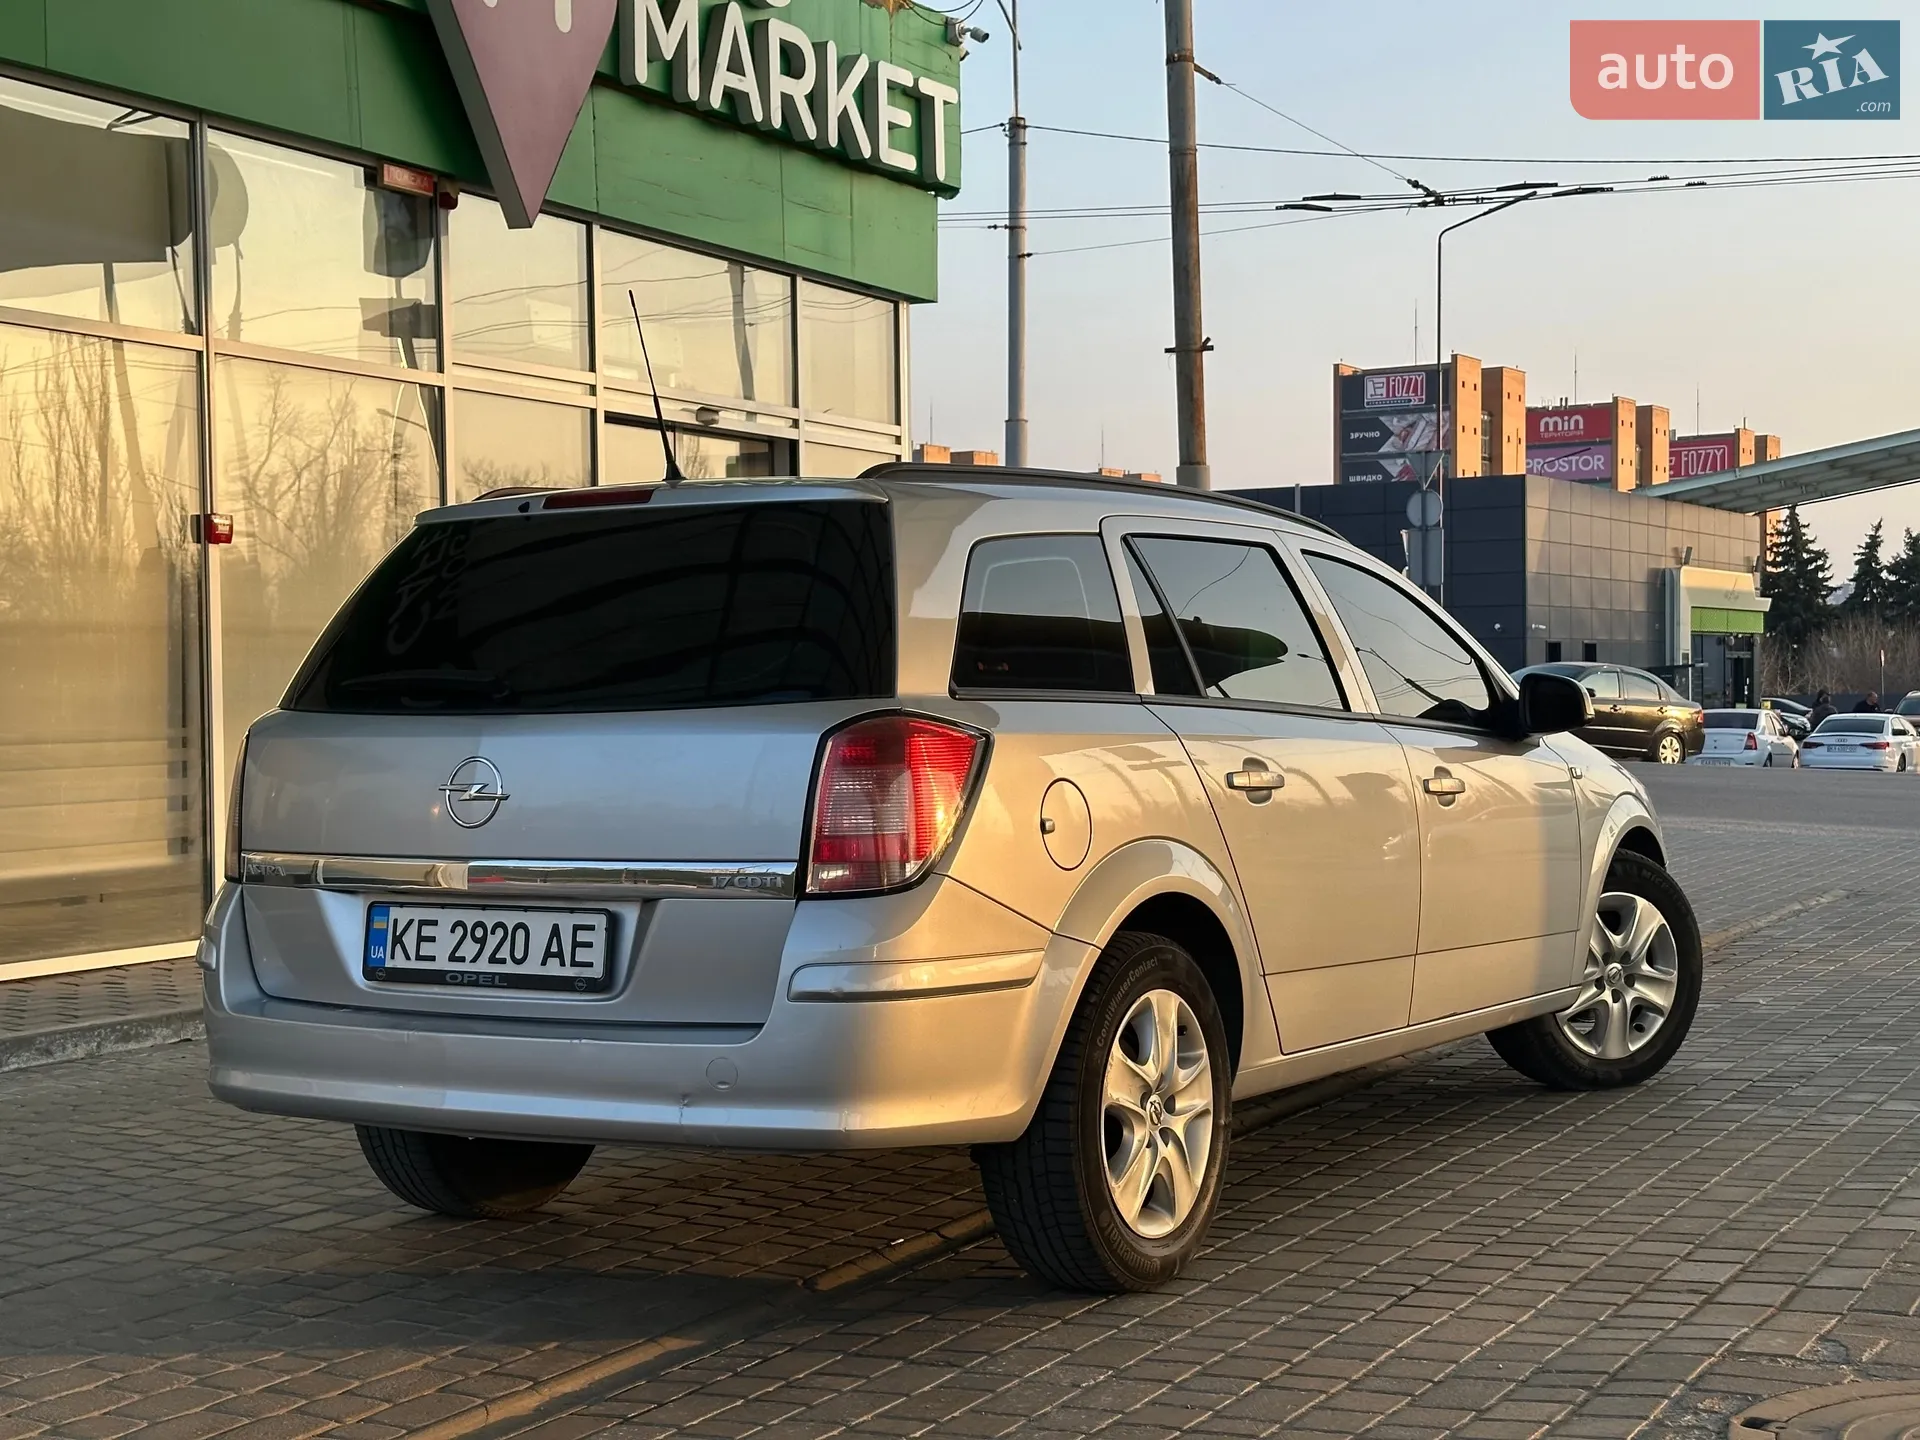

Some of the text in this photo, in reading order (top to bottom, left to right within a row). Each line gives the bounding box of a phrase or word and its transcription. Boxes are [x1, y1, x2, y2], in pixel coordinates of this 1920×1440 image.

[635, 0, 959, 182] MARKET
[1389, 375, 1423, 398] FOZZY
[1350, 430, 1380, 440] ЗРУЧНО
[1526, 455, 1604, 475] PROSTOR
[1681, 448, 1724, 476] FOZZY
[1349, 474, 1383, 482] ШВИДКО
[370, 945, 385, 959] UA
[390, 918, 596, 967] KE 2920 AE
[445, 972, 508, 985] OPEL
[1096, 956, 1158, 1047] ContiWinterContact
